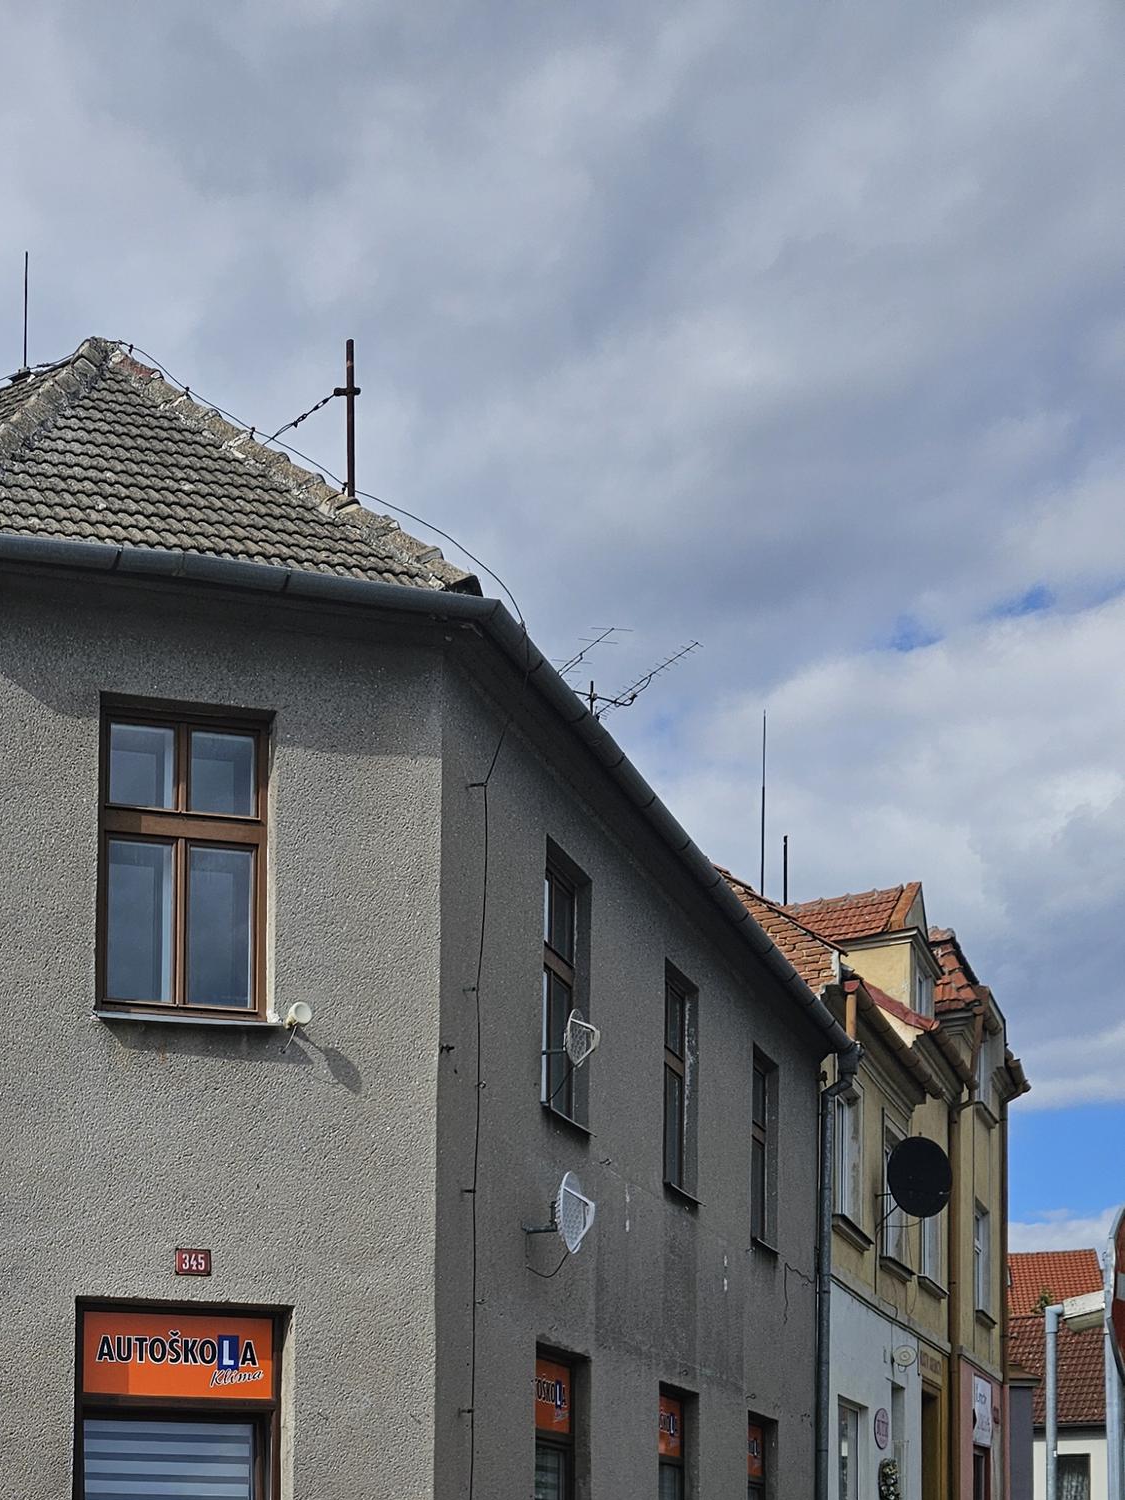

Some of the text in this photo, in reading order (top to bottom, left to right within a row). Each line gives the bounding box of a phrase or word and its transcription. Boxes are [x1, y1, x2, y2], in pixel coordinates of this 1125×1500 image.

[182, 1254, 205, 1270] 345
[96, 1330, 259, 1367] AUTOŠKOLA
[209, 1368, 264, 1388] Klima
